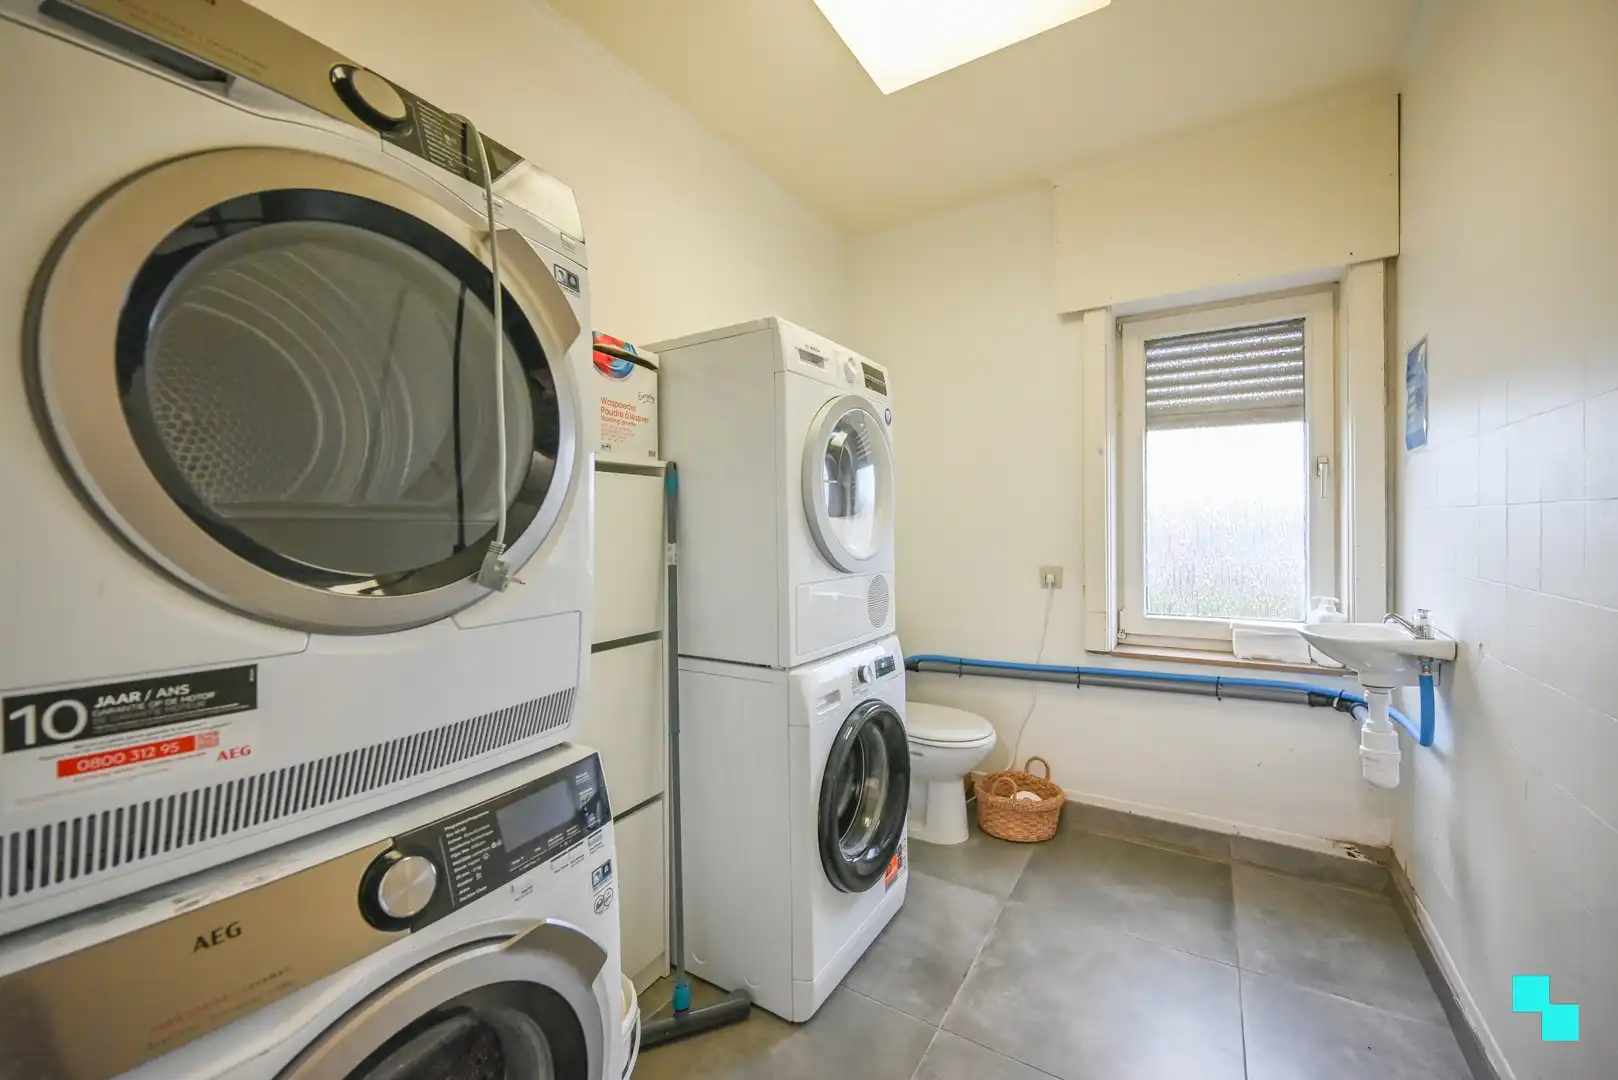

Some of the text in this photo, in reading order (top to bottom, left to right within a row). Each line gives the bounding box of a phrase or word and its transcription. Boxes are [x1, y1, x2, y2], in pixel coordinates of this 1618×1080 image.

[601, 406, 623, 418] Poudre
[94, 690, 142, 709] JAAR
[156, 684, 191, 698] ANS
[8, 699, 88, 746] 10
[76, 752, 127, 772] 0800
[129, 746, 156, 762] 312
[160, 742, 181, 755] 95
[216, 745, 252, 762] AEG
[192, 921, 243, 954] AEG
